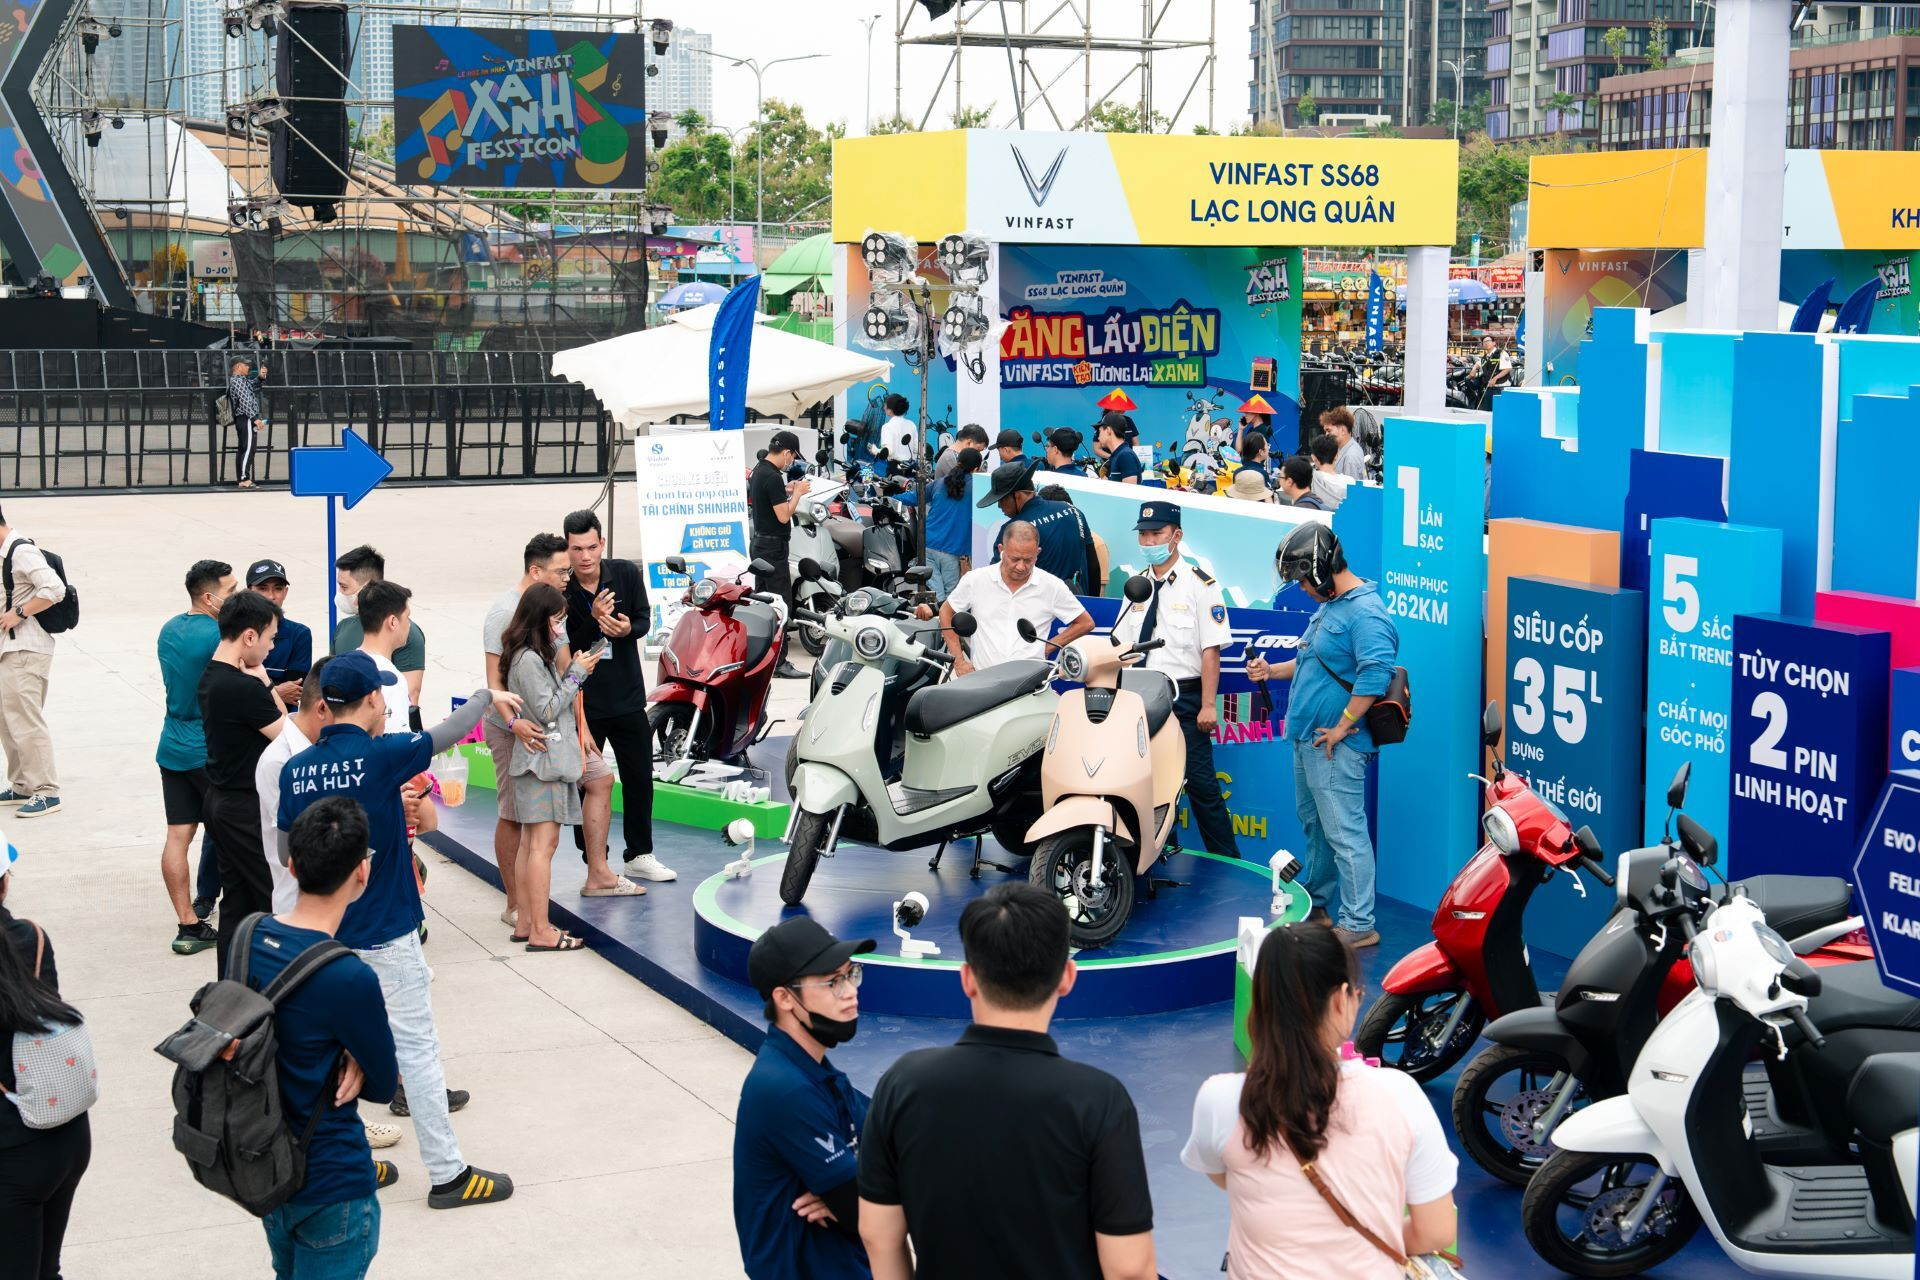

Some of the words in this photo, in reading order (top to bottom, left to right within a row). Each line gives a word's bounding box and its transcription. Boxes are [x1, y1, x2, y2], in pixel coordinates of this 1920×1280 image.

[506, 55, 572, 72] VINFAST
[461, 71, 575, 137] XANH
[1209, 163, 1314, 187] VINFAST
[1320, 164, 1379, 187] SS68
[1005, 216, 1075, 230] VINFAST
[1190, 199, 1239, 229] LẠC
[1248, 200, 1316, 224] LONG
[1324, 195, 1396, 224] QUÂN
[1059, 273, 1101, 284] VINFAST
[1246, 264, 1289, 293] XANH
[1578, 261, 1629, 272] VINFAST
[1027, 287, 1048, 297] SS68
[1051, 285, 1069, 297] LẠC
[1072, 285, 1097, 295] LONG
[1099, 280, 1124, 294] QUÂN
[1152, 363, 1199, 382] XANH
[697, 501, 746, 515] SHINHAN
[1030, 508, 1074, 527] VINFAST
[1397, 465, 1420, 547] 1
[1420, 503, 1443, 527] LẦN
[690, 526, 717, 537] KHÔNG
[720, 538, 730, 548] XE
[1420, 533, 1444, 554] SẠC
[1386, 571, 1418, 589] CHINH
[1420, 576, 1448, 596] PHỤC
[1663, 553, 1700, 633] 5
[1387, 590, 1448, 626] 262KM
[1513, 610, 1555, 645] SIÊU
[1559, 613, 1604, 654] CỐP
[1702, 614, 1732, 641] SẮC
[1659, 632, 1687, 658] BẮT
[1689, 643, 1733, 667] TREND
[1739, 648, 1781, 683] TÙY
[1784, 662, 1850, 698] CHỌN
[1658, 698, 1697, 724] CHẤT
[1699, 709, 1728, 732] MỌI
[1660, 724, 1692, 747] GÓC
[1695, 730, 1725, 754] PHỐ
[1750, 691, 1788, 771] 2
[1512, 741, 1545, 762] ĐỰNG
[1794, 746, 1837, 782] PIN
[292, 758, 364, 779] VINFAST
[292, 781, 318, 795] GIA
[323, 772, 366, 790] HUY
[1537, 775, 1566, 805] THẾ
[1568, 786, 1602, 815] GIỚI
[1735, 773, 1781, 806] LINH
[1785, 784, 1848, 824] HOẠT
[1883, 828, 1916, 853] EVO
